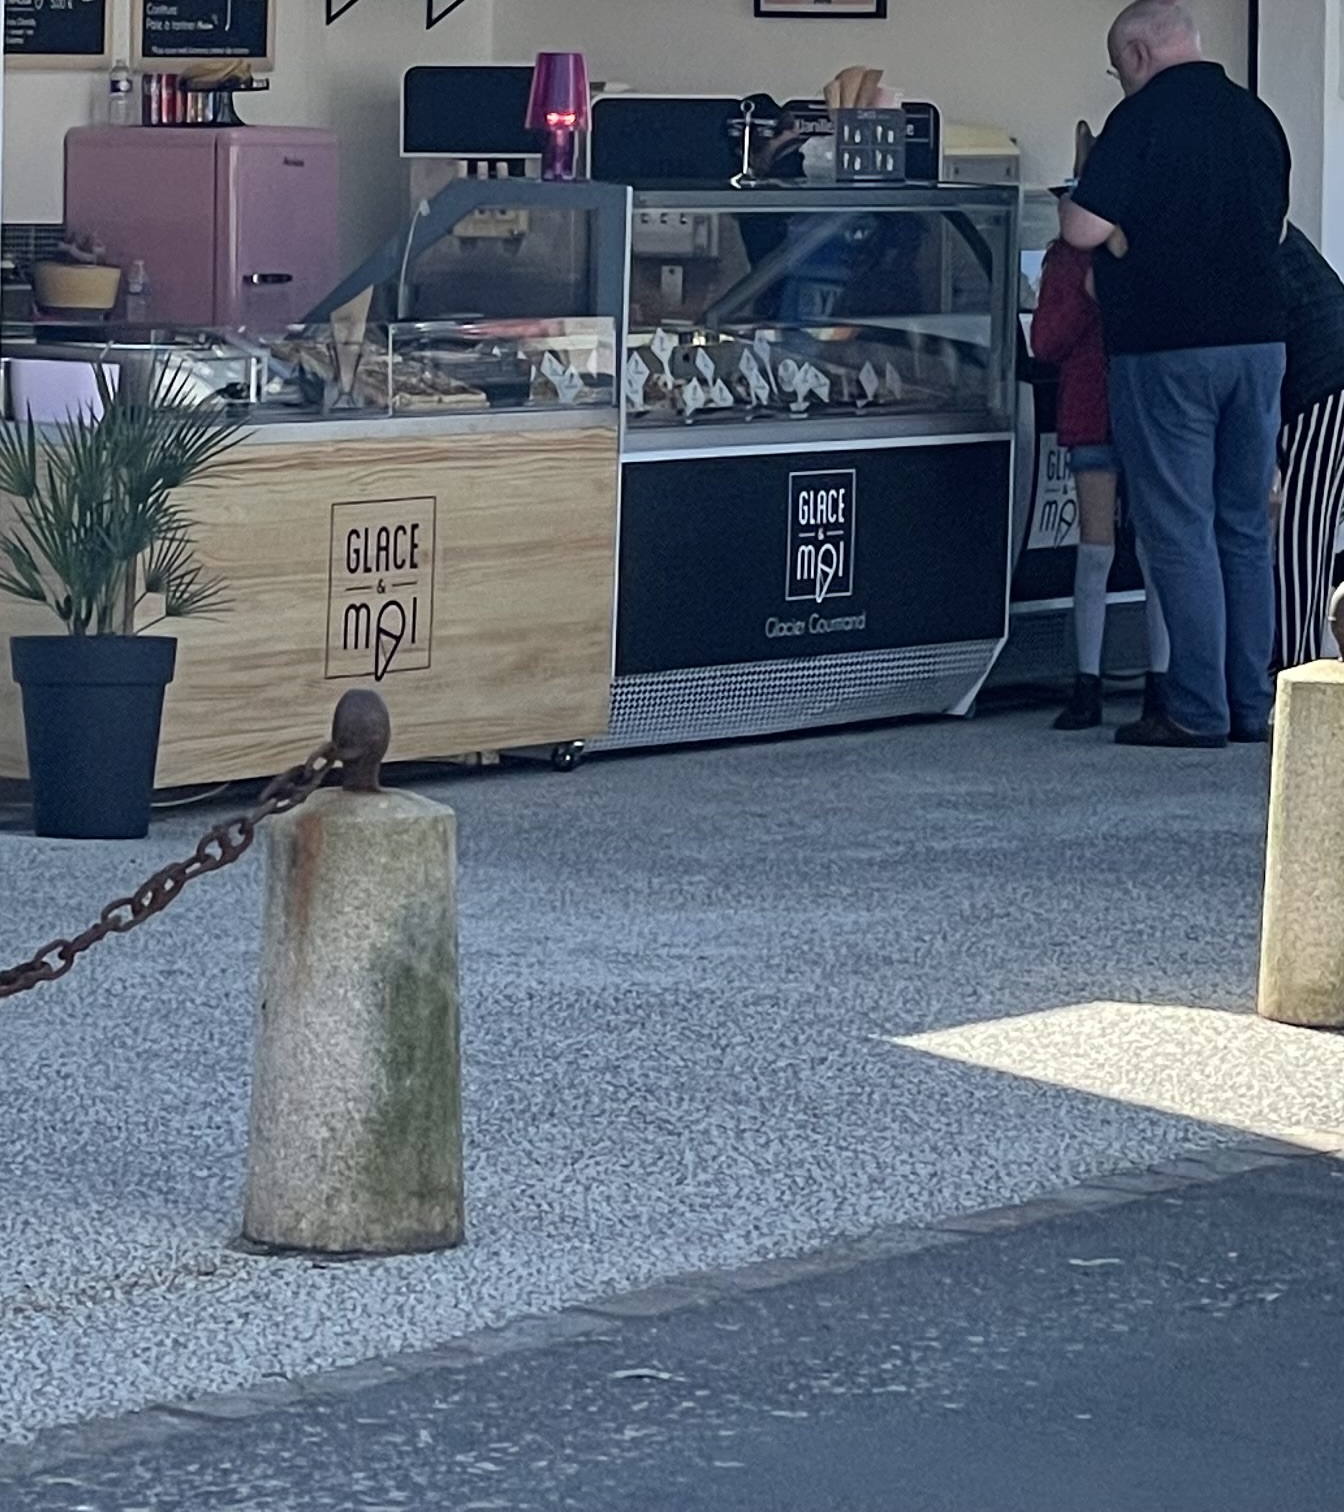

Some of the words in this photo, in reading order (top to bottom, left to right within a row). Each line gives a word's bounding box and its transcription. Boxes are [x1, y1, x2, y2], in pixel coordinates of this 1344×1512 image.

[1046, 449, 1071, 481] GLA
[798, 488, 846, 525] GLACE
[1039, 498, 1077, 548] MO
[346, 523, 420, 574] GLACE
[797, 540, 845, 603] MOI
[376, 578, 386, 594] &
[343, 596, 418, 682] MOI
